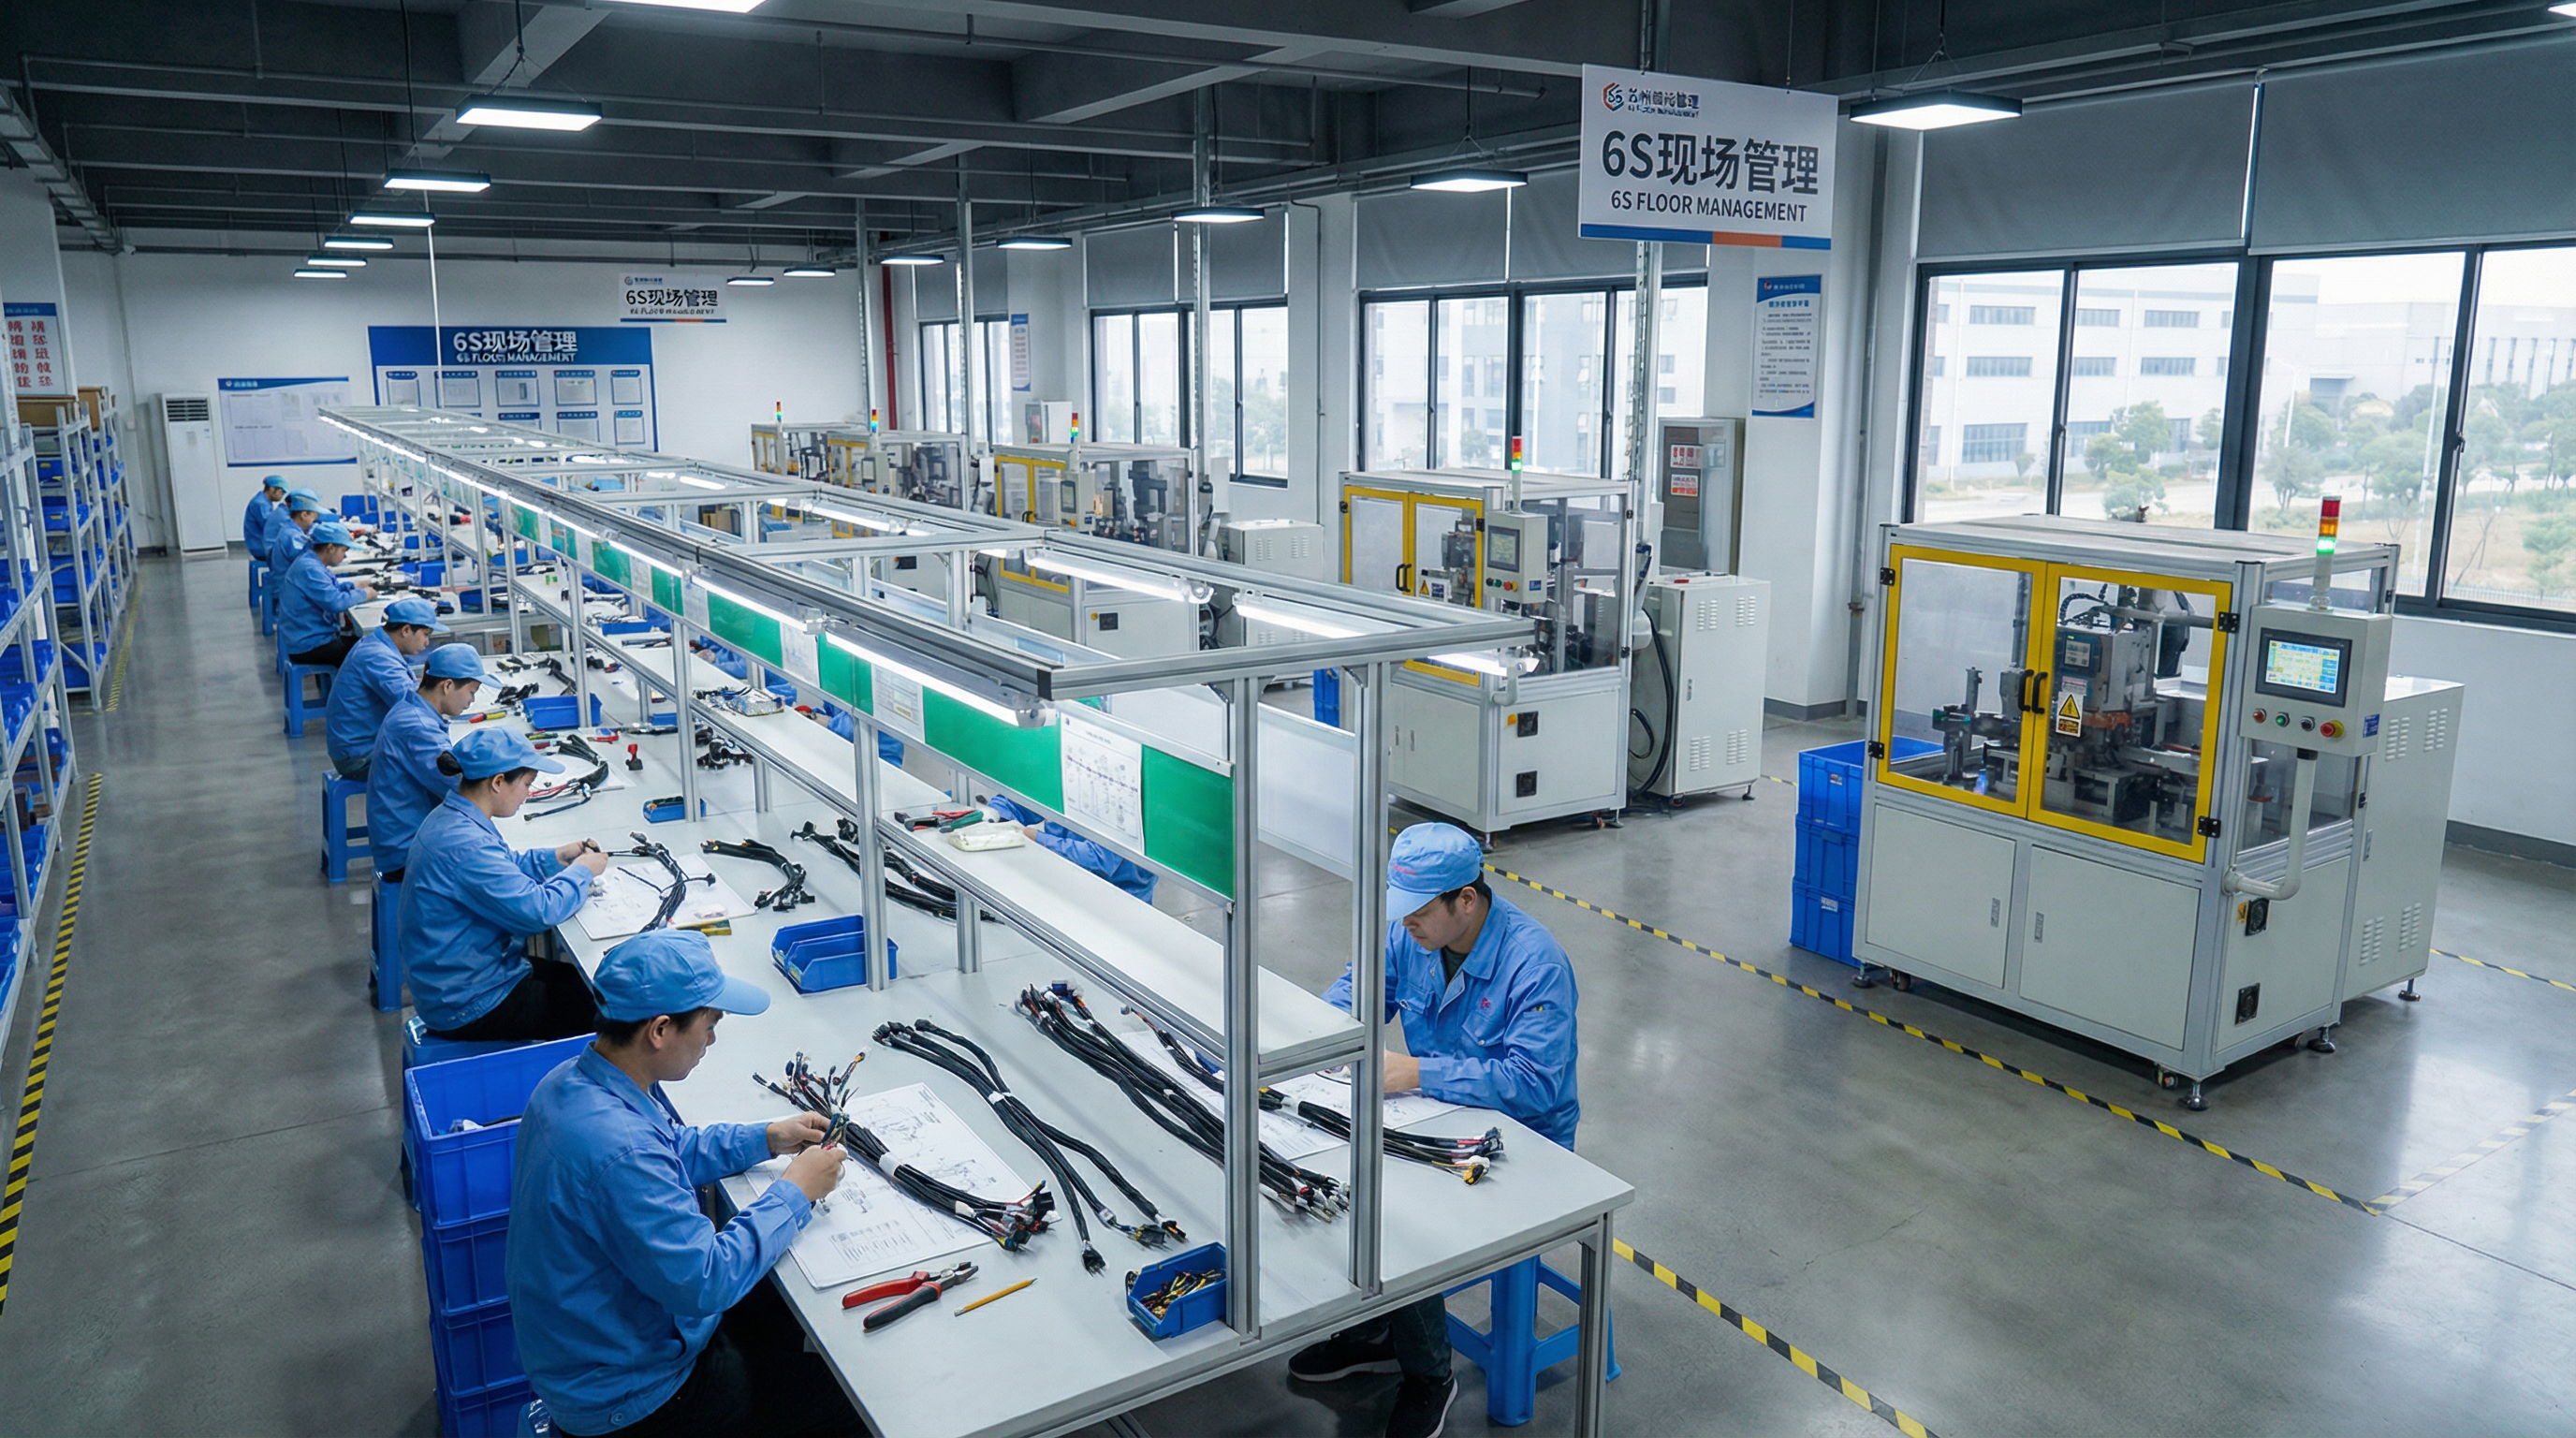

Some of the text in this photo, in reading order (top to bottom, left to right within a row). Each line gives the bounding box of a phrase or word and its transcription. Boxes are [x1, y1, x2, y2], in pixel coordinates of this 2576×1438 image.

[1602, 130, 1819, 195] 6S现场管理
[1611, 190, 1808, 222] 6S FLOOR MANAGEMENT
[453, 330, 578, 353] 6S现场管理
